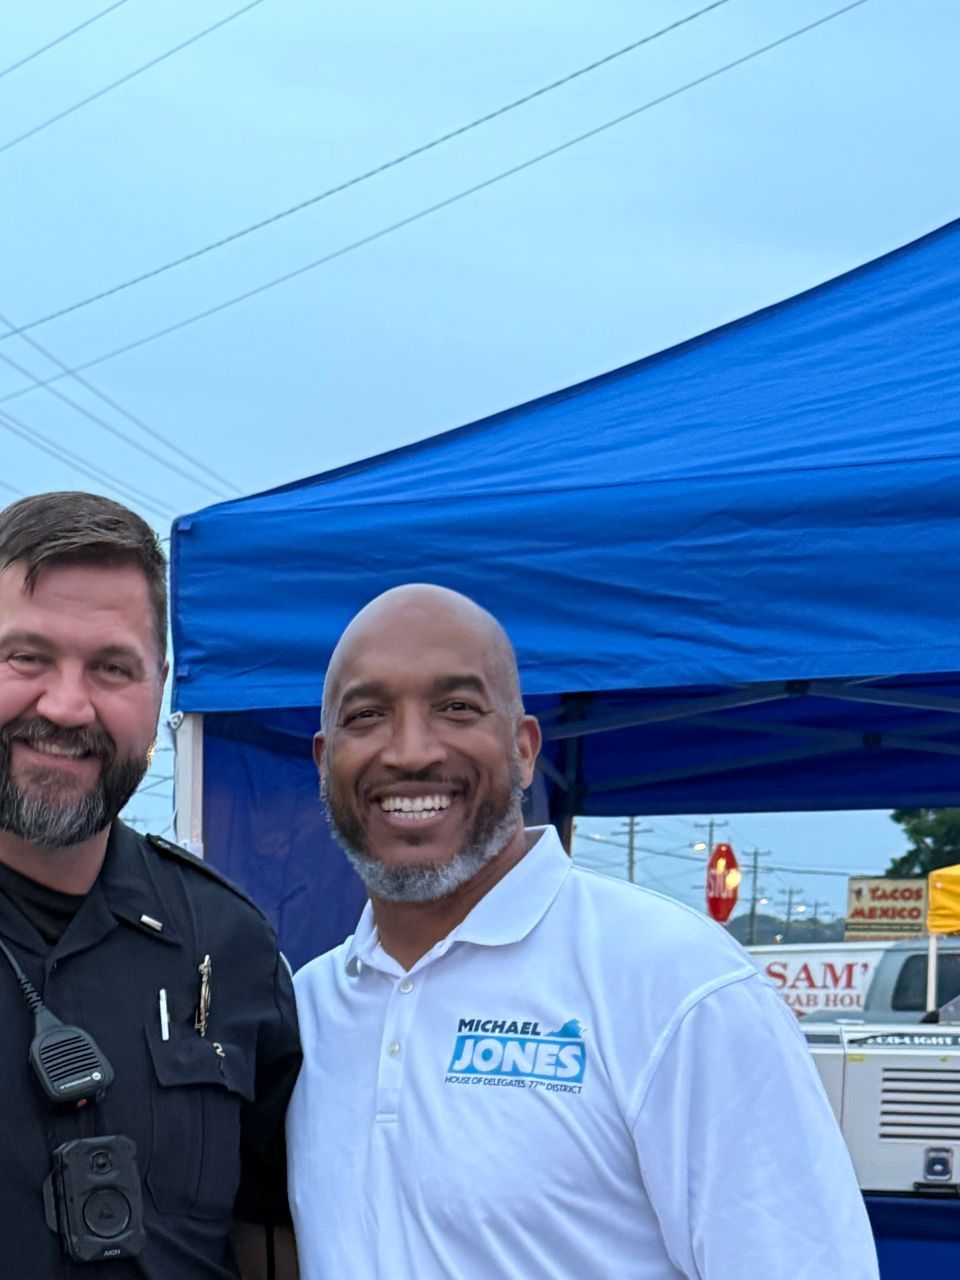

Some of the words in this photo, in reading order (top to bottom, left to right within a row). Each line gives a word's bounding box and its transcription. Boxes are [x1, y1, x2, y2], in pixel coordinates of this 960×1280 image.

[870, 887, 923, 901] TACOS
[851, 907, 921, 920] MEXICO
[457, 1018, 541, 1036] MICHAEL
[452, 1038, 581, 1079] JONES
[444, 1075, 471, 1085] HOUSE
[471, 1076, 483, 1085] OF
[482, 1077, 526, 1088] DELEGATES
[545, 1082, 583, 1095] DISTRICT
